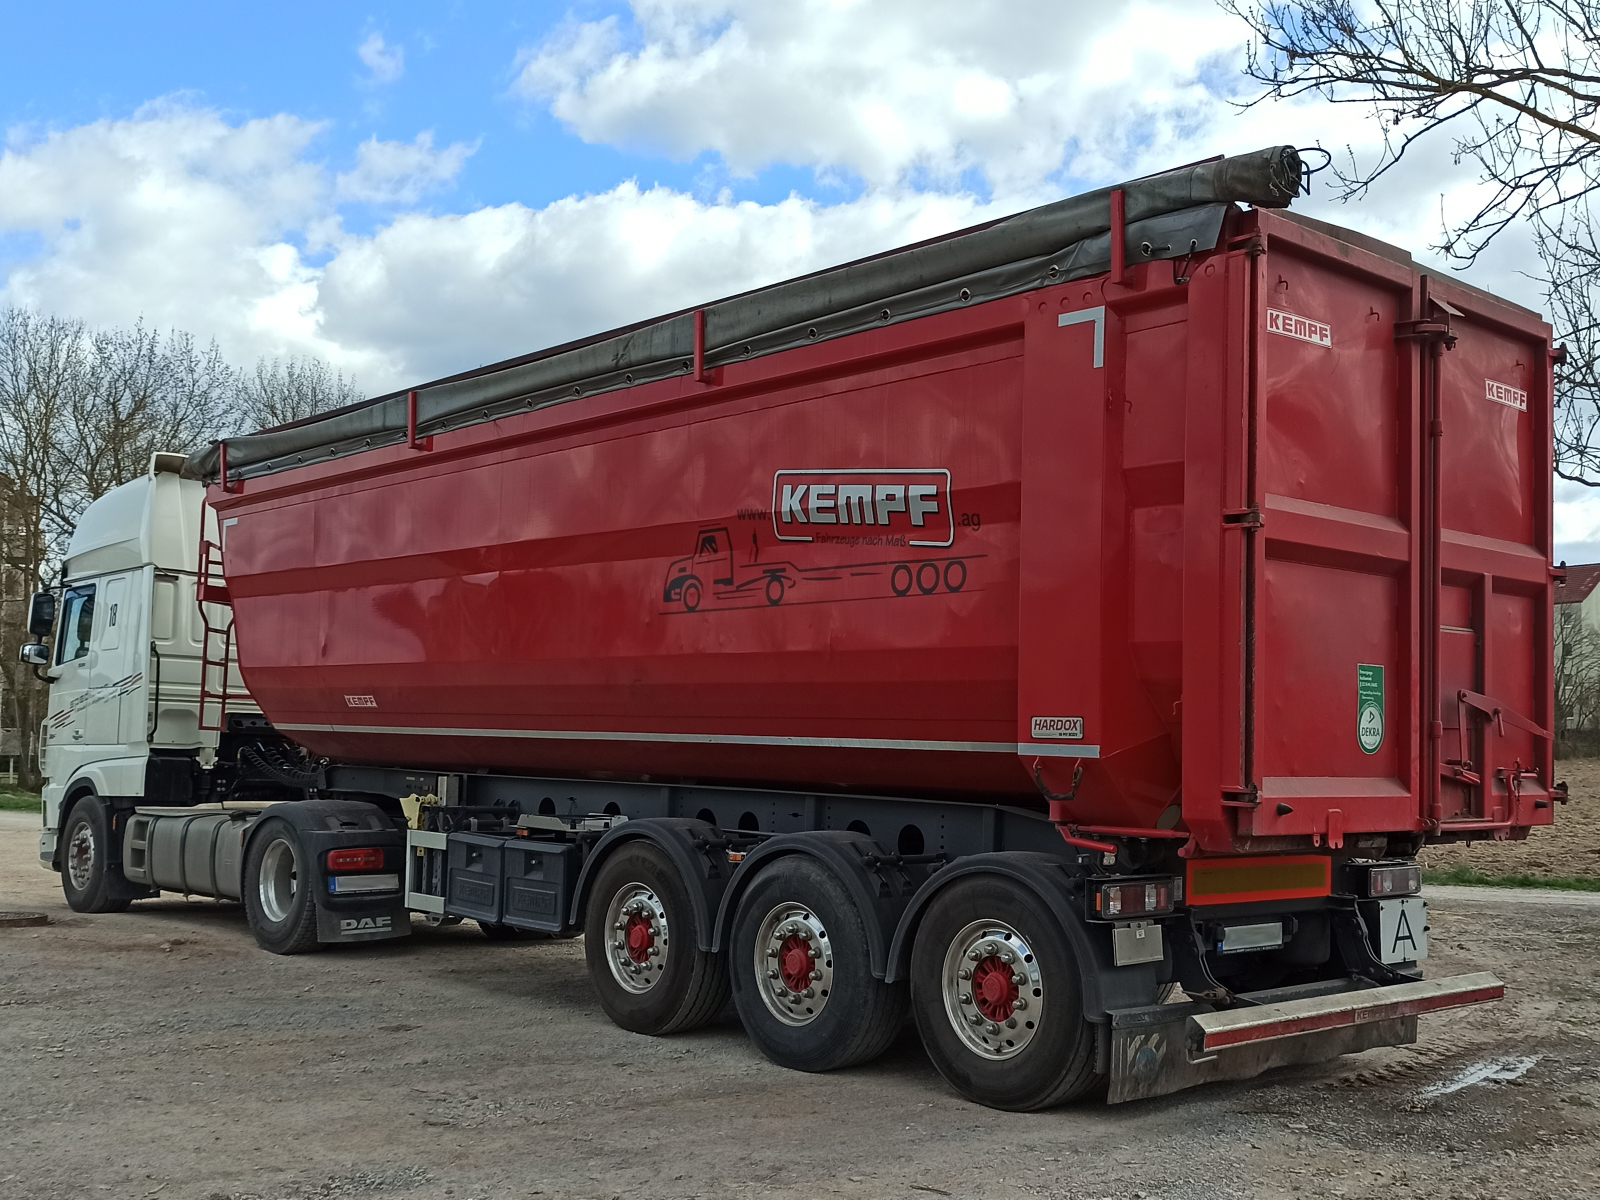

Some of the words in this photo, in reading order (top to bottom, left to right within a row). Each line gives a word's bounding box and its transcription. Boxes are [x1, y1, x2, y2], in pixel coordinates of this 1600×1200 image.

[1269, 311, 1329, 342] KEMPF
[1487, 382, 1526, 407] KEMPF
[736, 508, 771, 521] www.
[780, 484, 939, 526] KEMPF
[957, 512, 981, 531] .ag
[816, 532, 860, 546] Fahrzeuge
[862, 534, 883, 546] nach
[885, 535, 906, 547] Maß
[108, 603, 118, 627] 18
[345, 696, 375, 706] KEMPF
[1034, 719, 1079, 731] HARDOX
[1361, 727, 1380, 736] DEKRA
[340, 916, 391, 930] DAF
[1391, 909, 1417, 954] A
